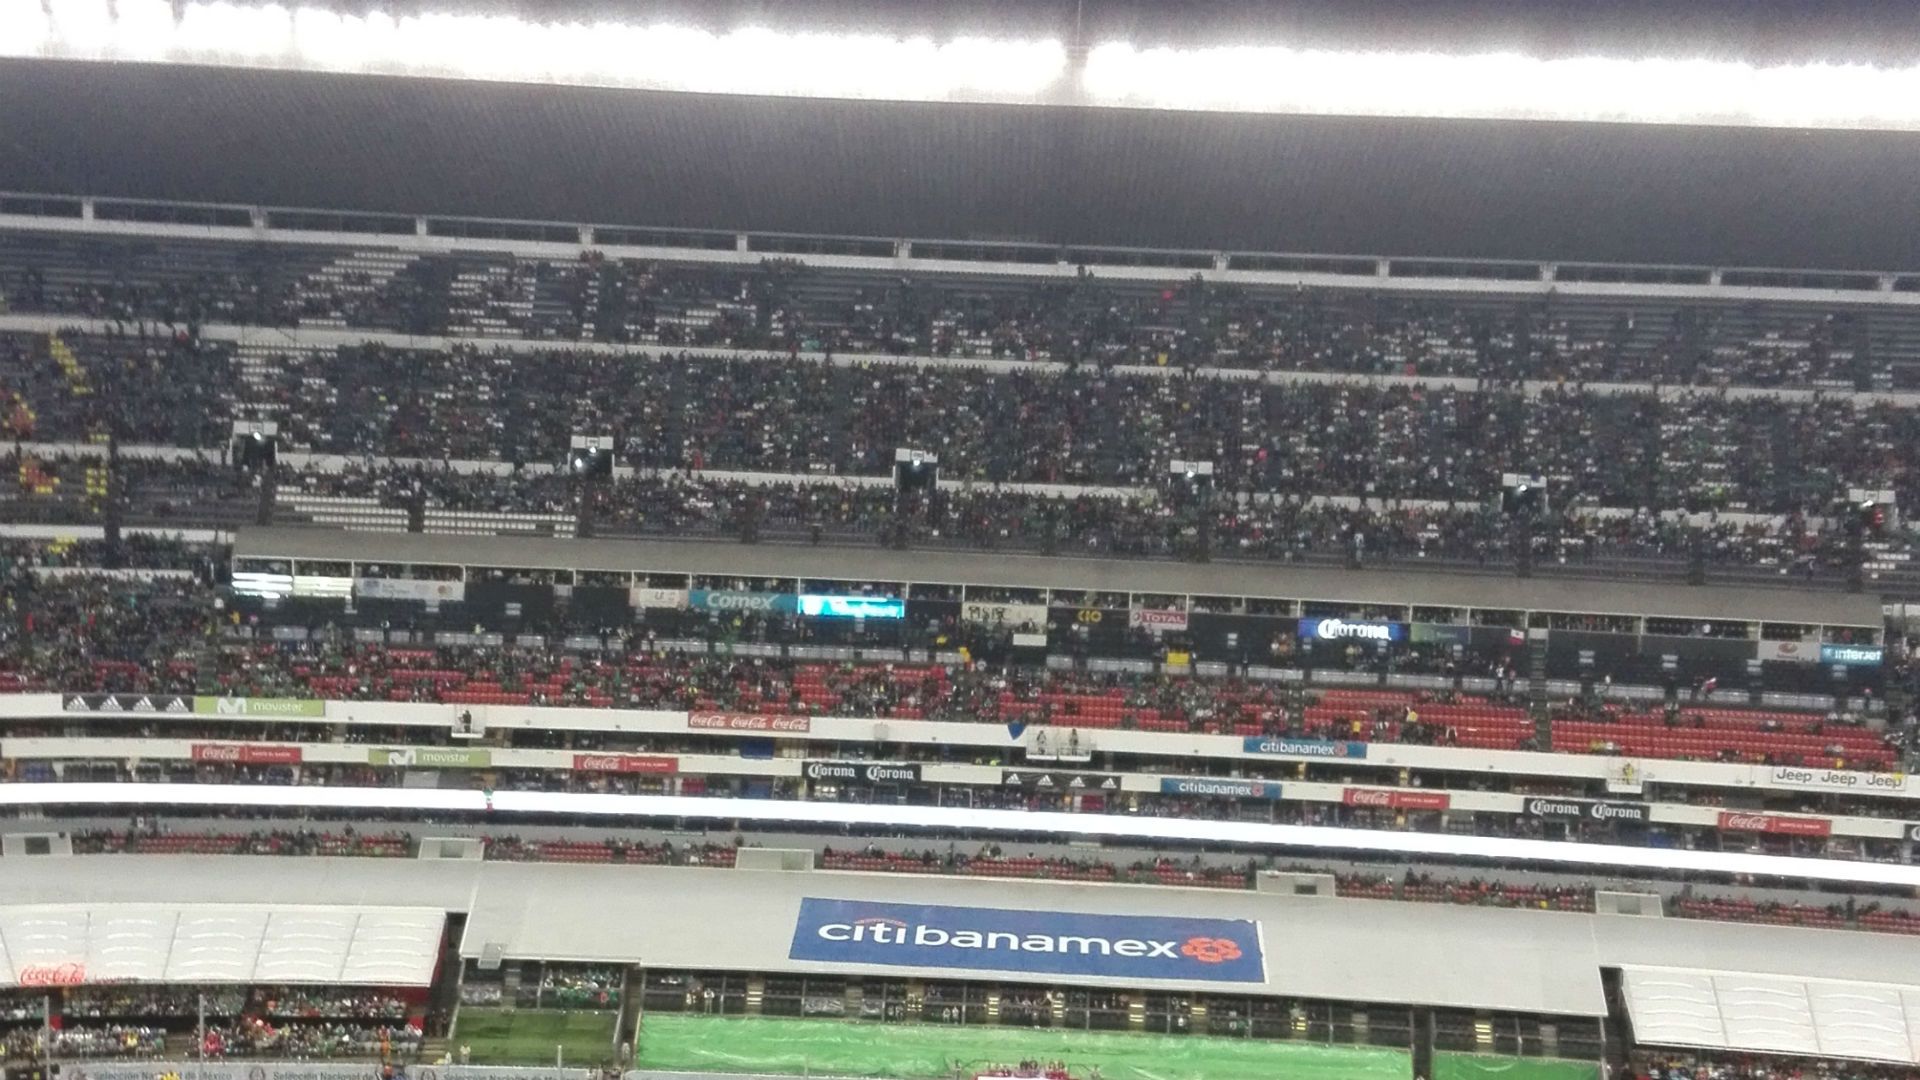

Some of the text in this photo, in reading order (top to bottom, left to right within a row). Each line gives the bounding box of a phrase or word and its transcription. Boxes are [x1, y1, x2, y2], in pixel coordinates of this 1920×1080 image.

[707, 592, 780, 609] Comex
[1143, 612, 1184, 623] TOTAL
[1317, 618, 1392, 640] Corona
[254, 701, 303, 712] movistar
[1260, 741, 1335, 755] citibanamex
[423, 751, 470, 763] movistar
[807, 763, 915, 782] Corona Corona
[1776, 769, 1902, 789] Jeep Jeep Jeep
[1179, 782, 1251, 796] citibanamex
[1529, 800, 1643, 820] Corona Corona
[817, 919, 1178, 959] citibanamex
